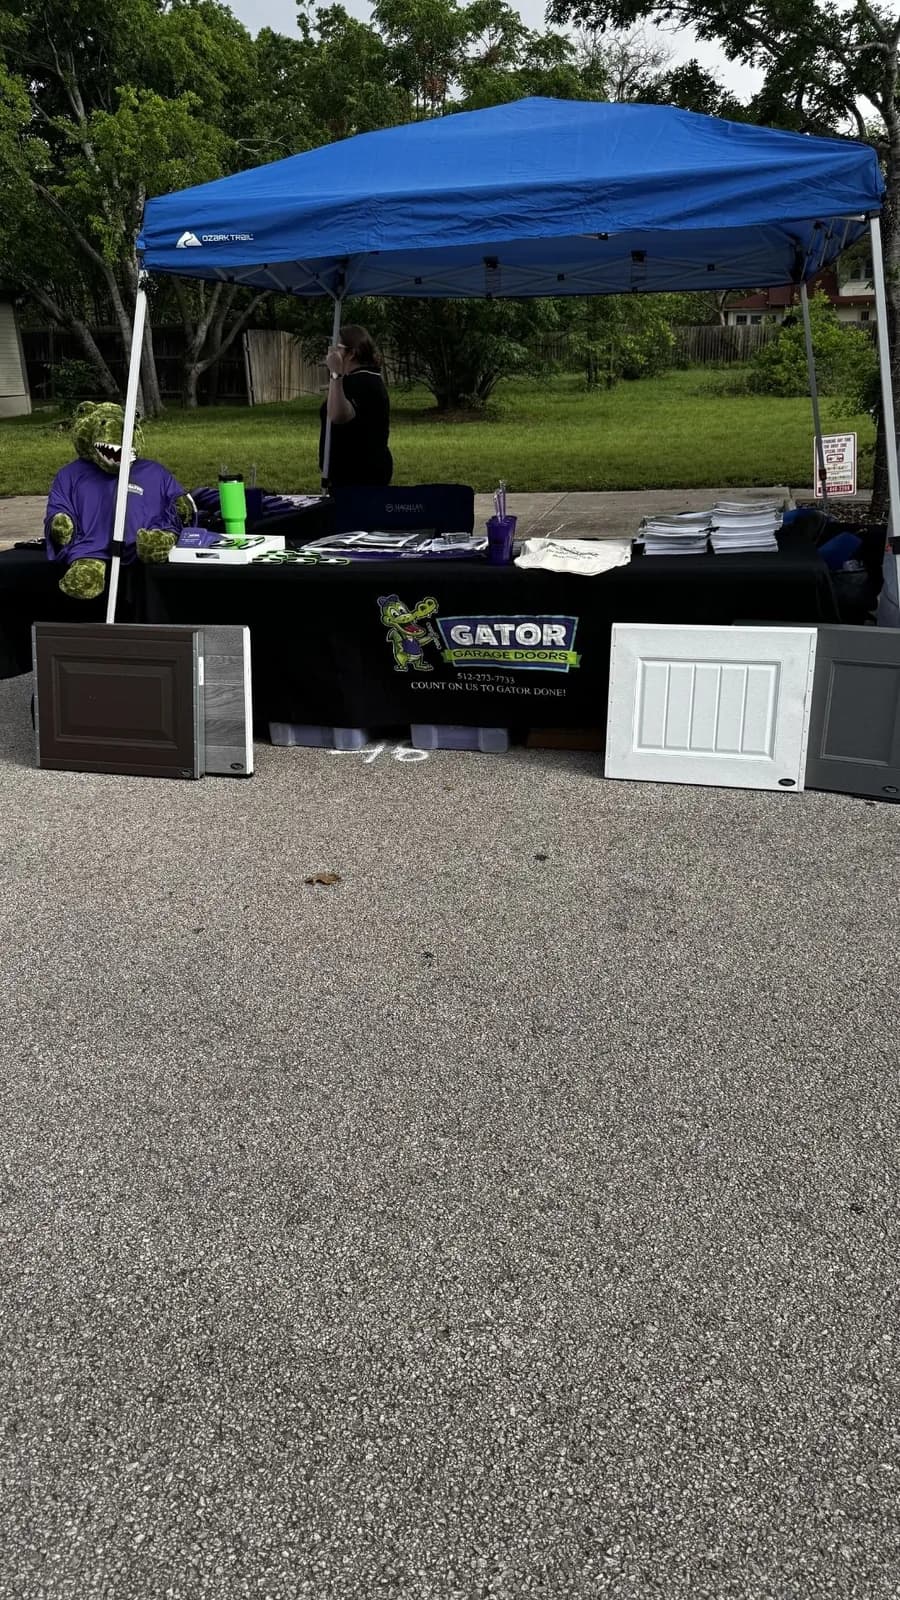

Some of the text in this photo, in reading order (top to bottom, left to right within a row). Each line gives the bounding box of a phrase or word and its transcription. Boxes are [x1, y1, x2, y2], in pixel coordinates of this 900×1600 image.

[202, 233, 254, 242] OZARK TRAIL
[450, 622, 567, 646] GATOR
[452, 649, 569, 661] GARAGE DOORS
[456, 672, 515, 684] 512-273-7733
[410, 681, 567, 697] COUNT ON US TO GATOR DONE!
